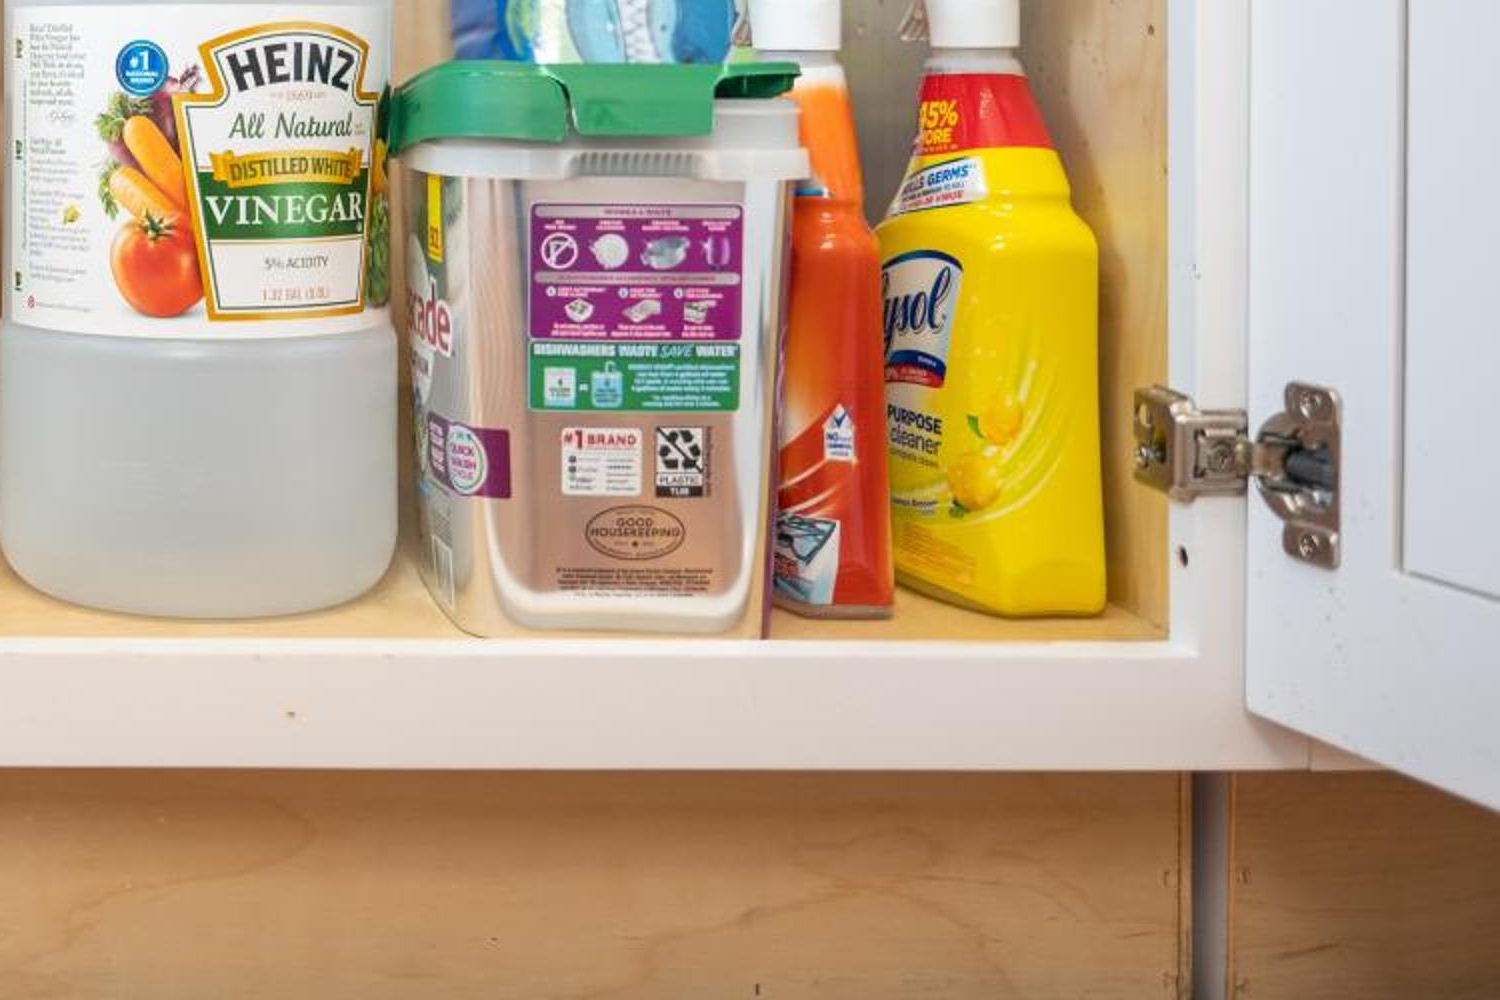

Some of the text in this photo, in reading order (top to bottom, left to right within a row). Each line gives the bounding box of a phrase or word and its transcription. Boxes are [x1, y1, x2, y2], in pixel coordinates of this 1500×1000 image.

[226, 41, 355, 92] HEINZ
[228, 110, 353, 139] All Natural
[230, 156, 351, 181] DISTILLED WHITE
[205, 192, 364, 226] VINEGAR
[286, 255, 329, 269] ACIDITY
[887, 404, 942, 436] PURPOSE
[587, 434, 637, 446] BRAND
[889, 425, 942, 456] cleaner
[659, 475, 699, 486] PLASTIC
[590, 527, 680, 538] HOUSEKEEPING
[616, 517, 653, 527] GOOD
